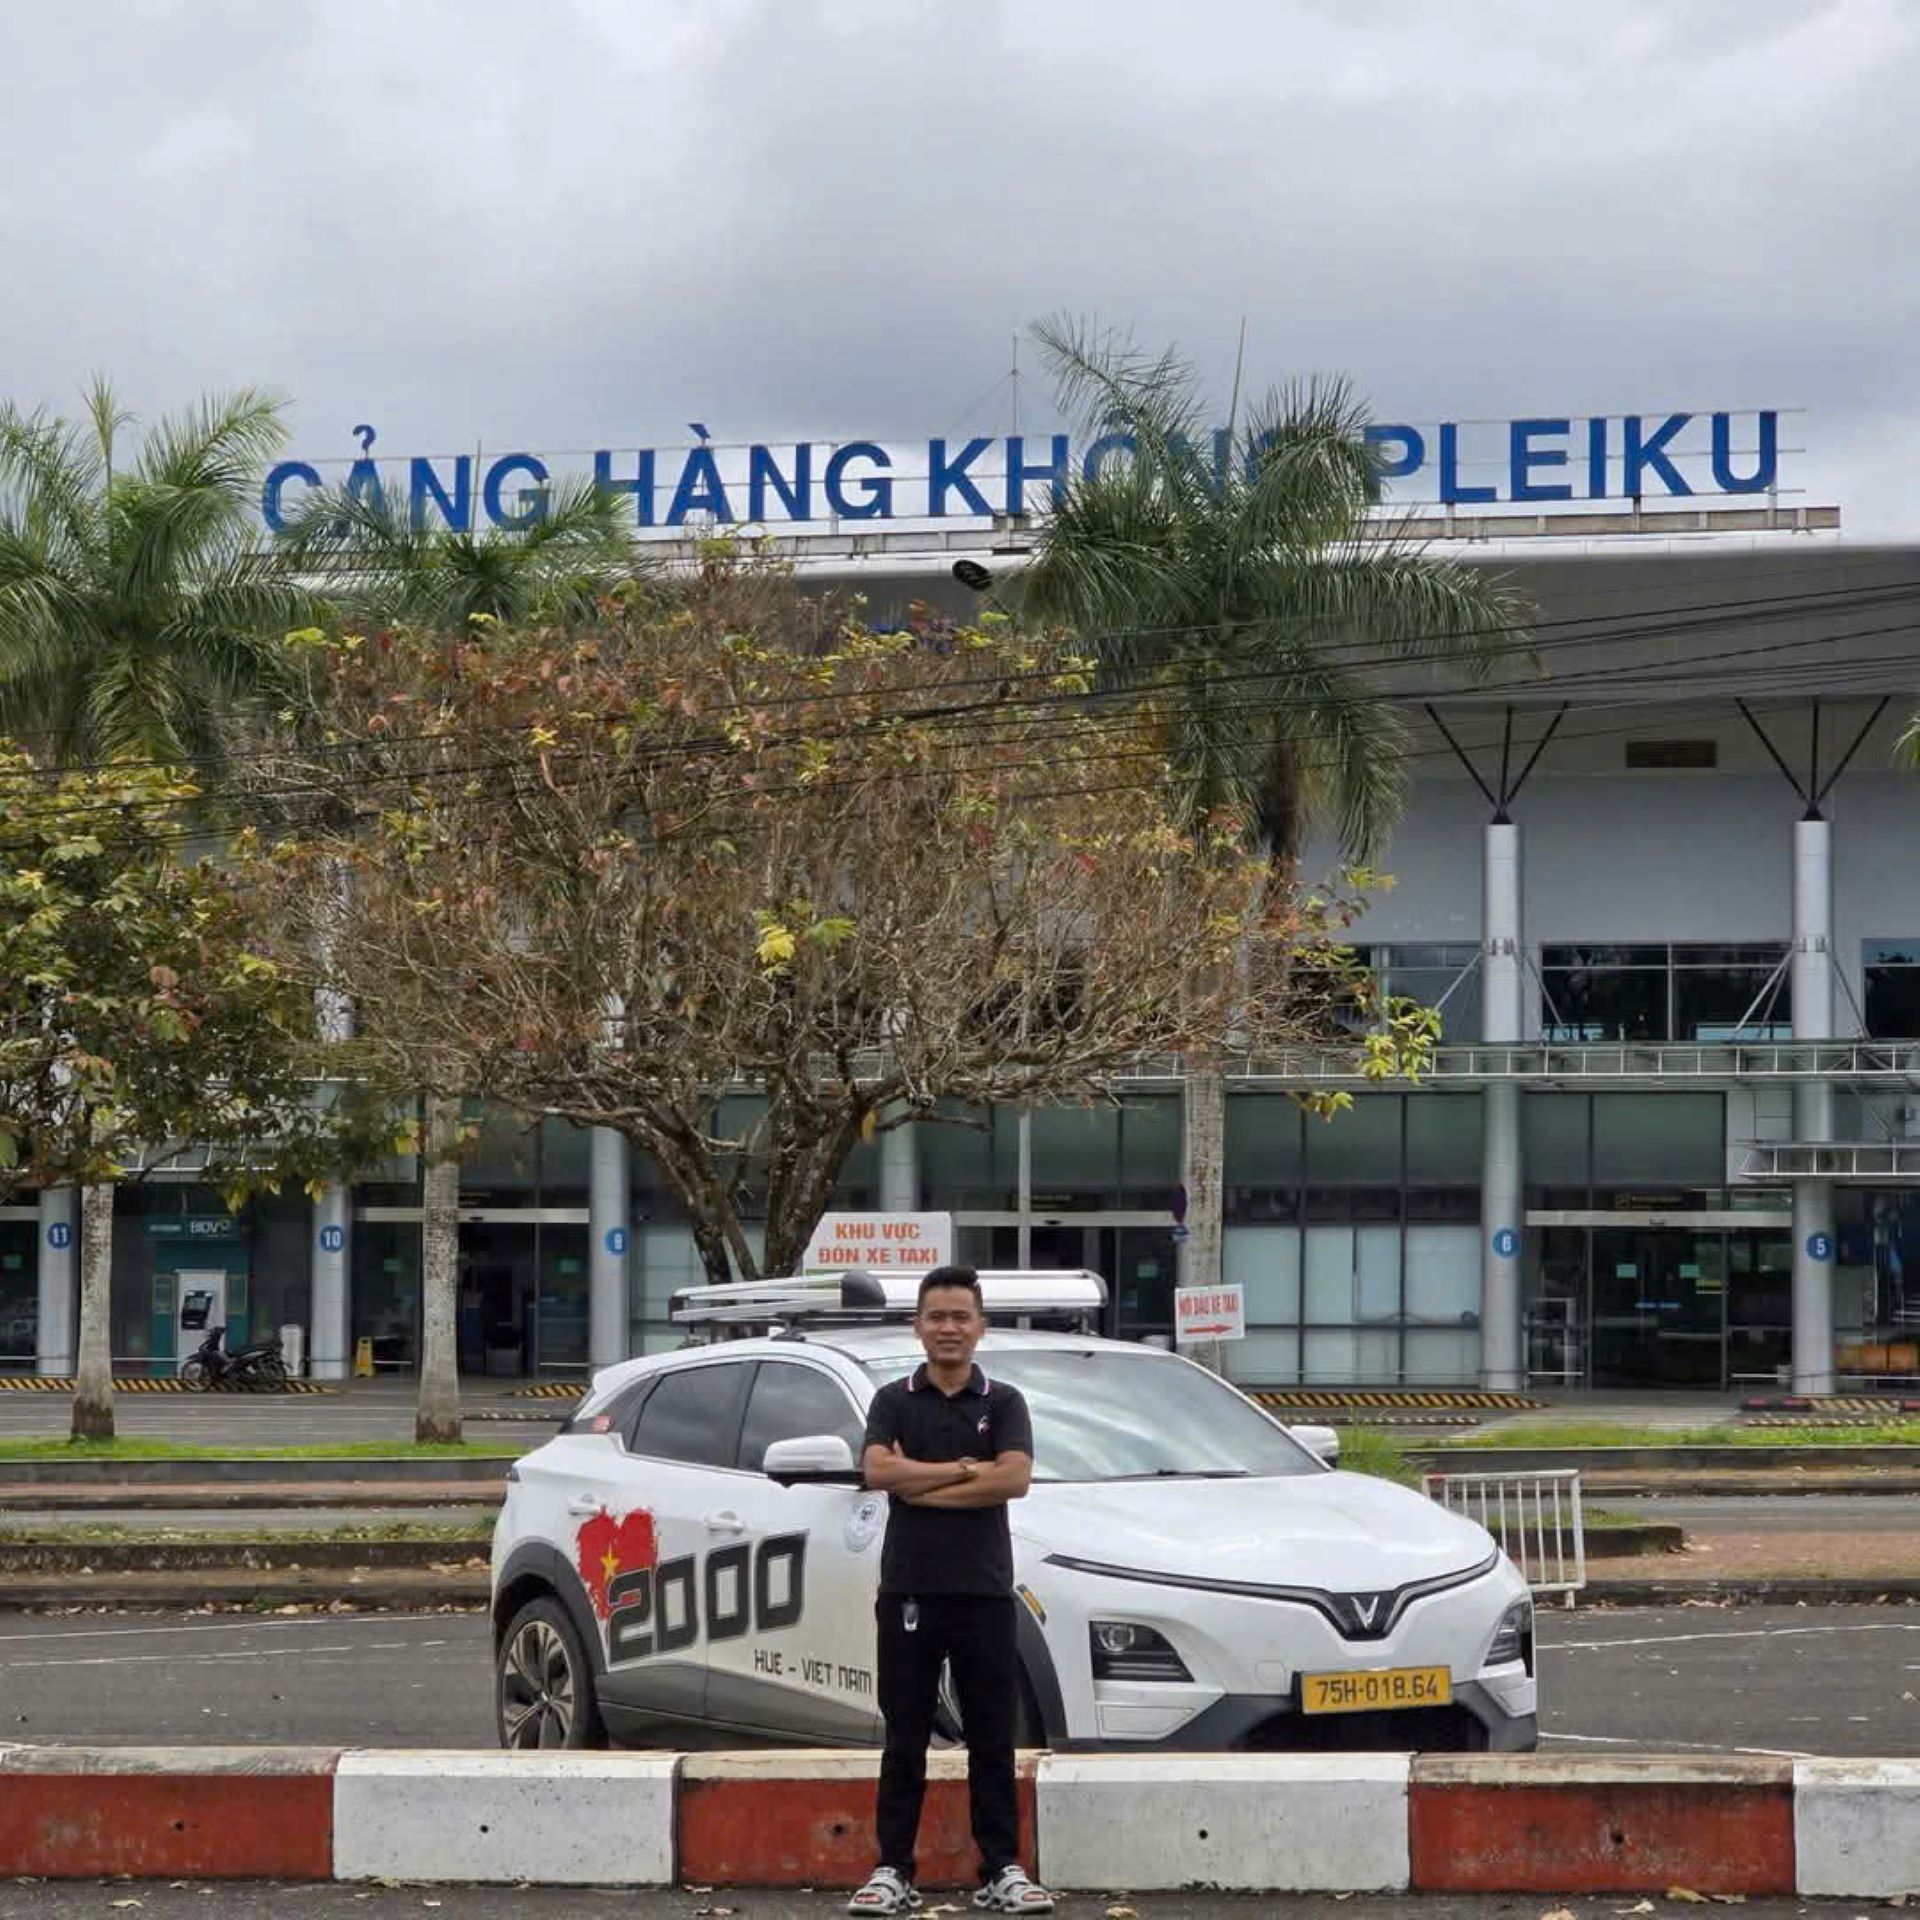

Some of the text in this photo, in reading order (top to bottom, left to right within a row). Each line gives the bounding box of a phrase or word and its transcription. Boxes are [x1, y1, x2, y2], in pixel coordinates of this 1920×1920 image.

[263, 424, 550, 535] CẢNG
[594, 423, 892, 526] HÀNG
[1363, 410, 1777, 505] PLEIKU
[53, 1226, 68, 1244] 11
[324, 1230, 341, 1248] 10
[835, 1222, 875, 1240] KHU
[866, 1247, 891, 1264] XE
[897, 1247, 939, 1264] TAXI
[1816, 1237, 1826, 1256] 5
[608, 1529, 810, 1667] 2000
[754, 1648, 783, 1675] HUE
[801, 1657, 832, 1687] VIET
[1316, 1672, 1438, 1706] 75H-018.64
